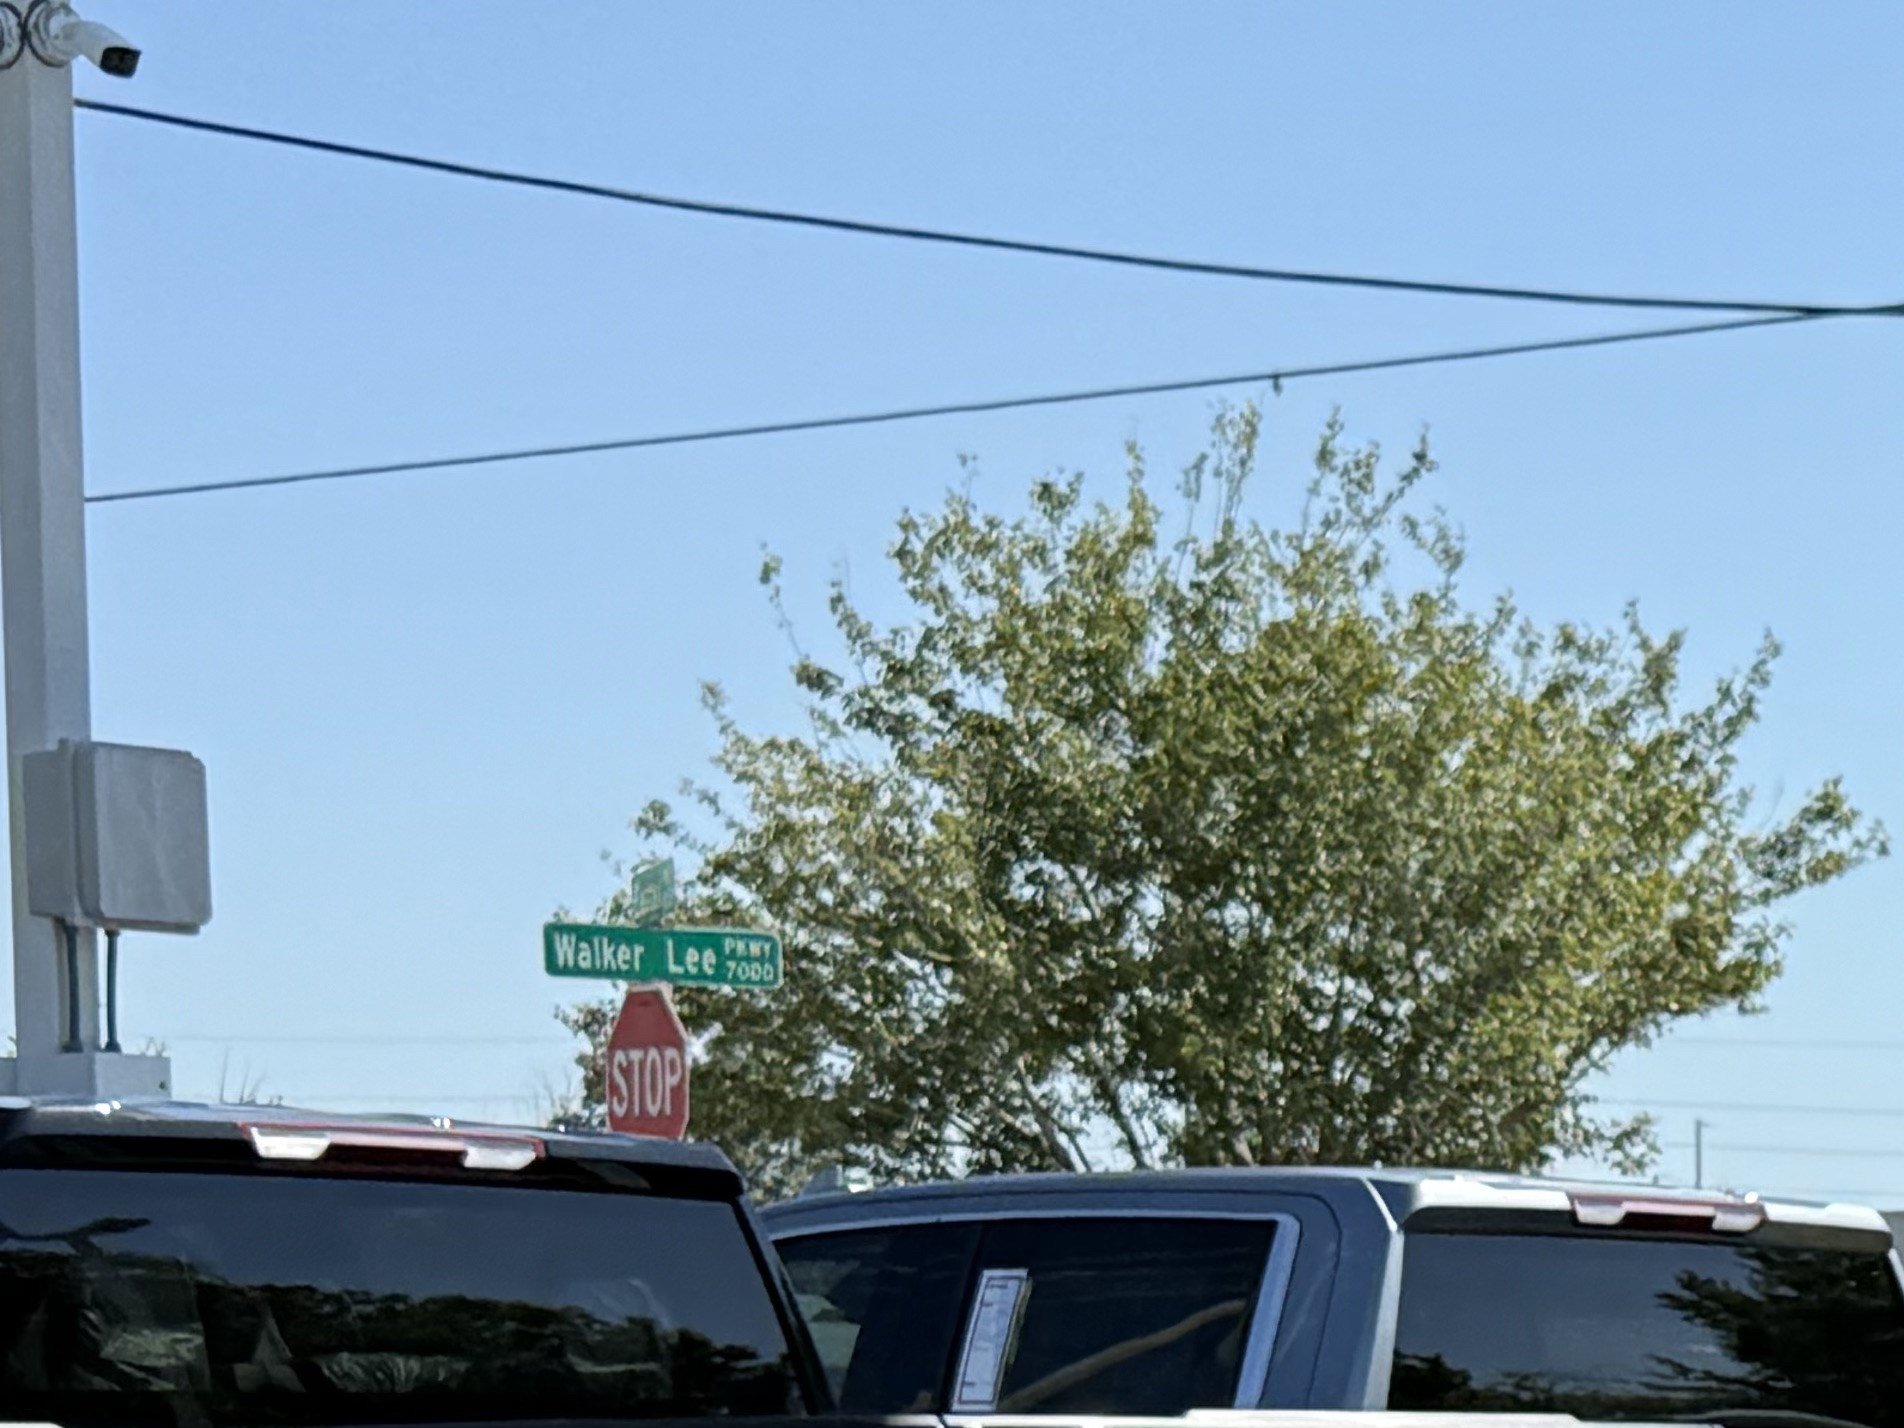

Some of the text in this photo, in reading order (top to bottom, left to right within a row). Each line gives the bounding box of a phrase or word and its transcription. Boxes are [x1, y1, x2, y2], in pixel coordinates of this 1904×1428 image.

[553, 931, 771, 975] Walker Lee PKWY
[726, 961, 774, 981] 7000
[612, 1047, 682, 1118] STOP
